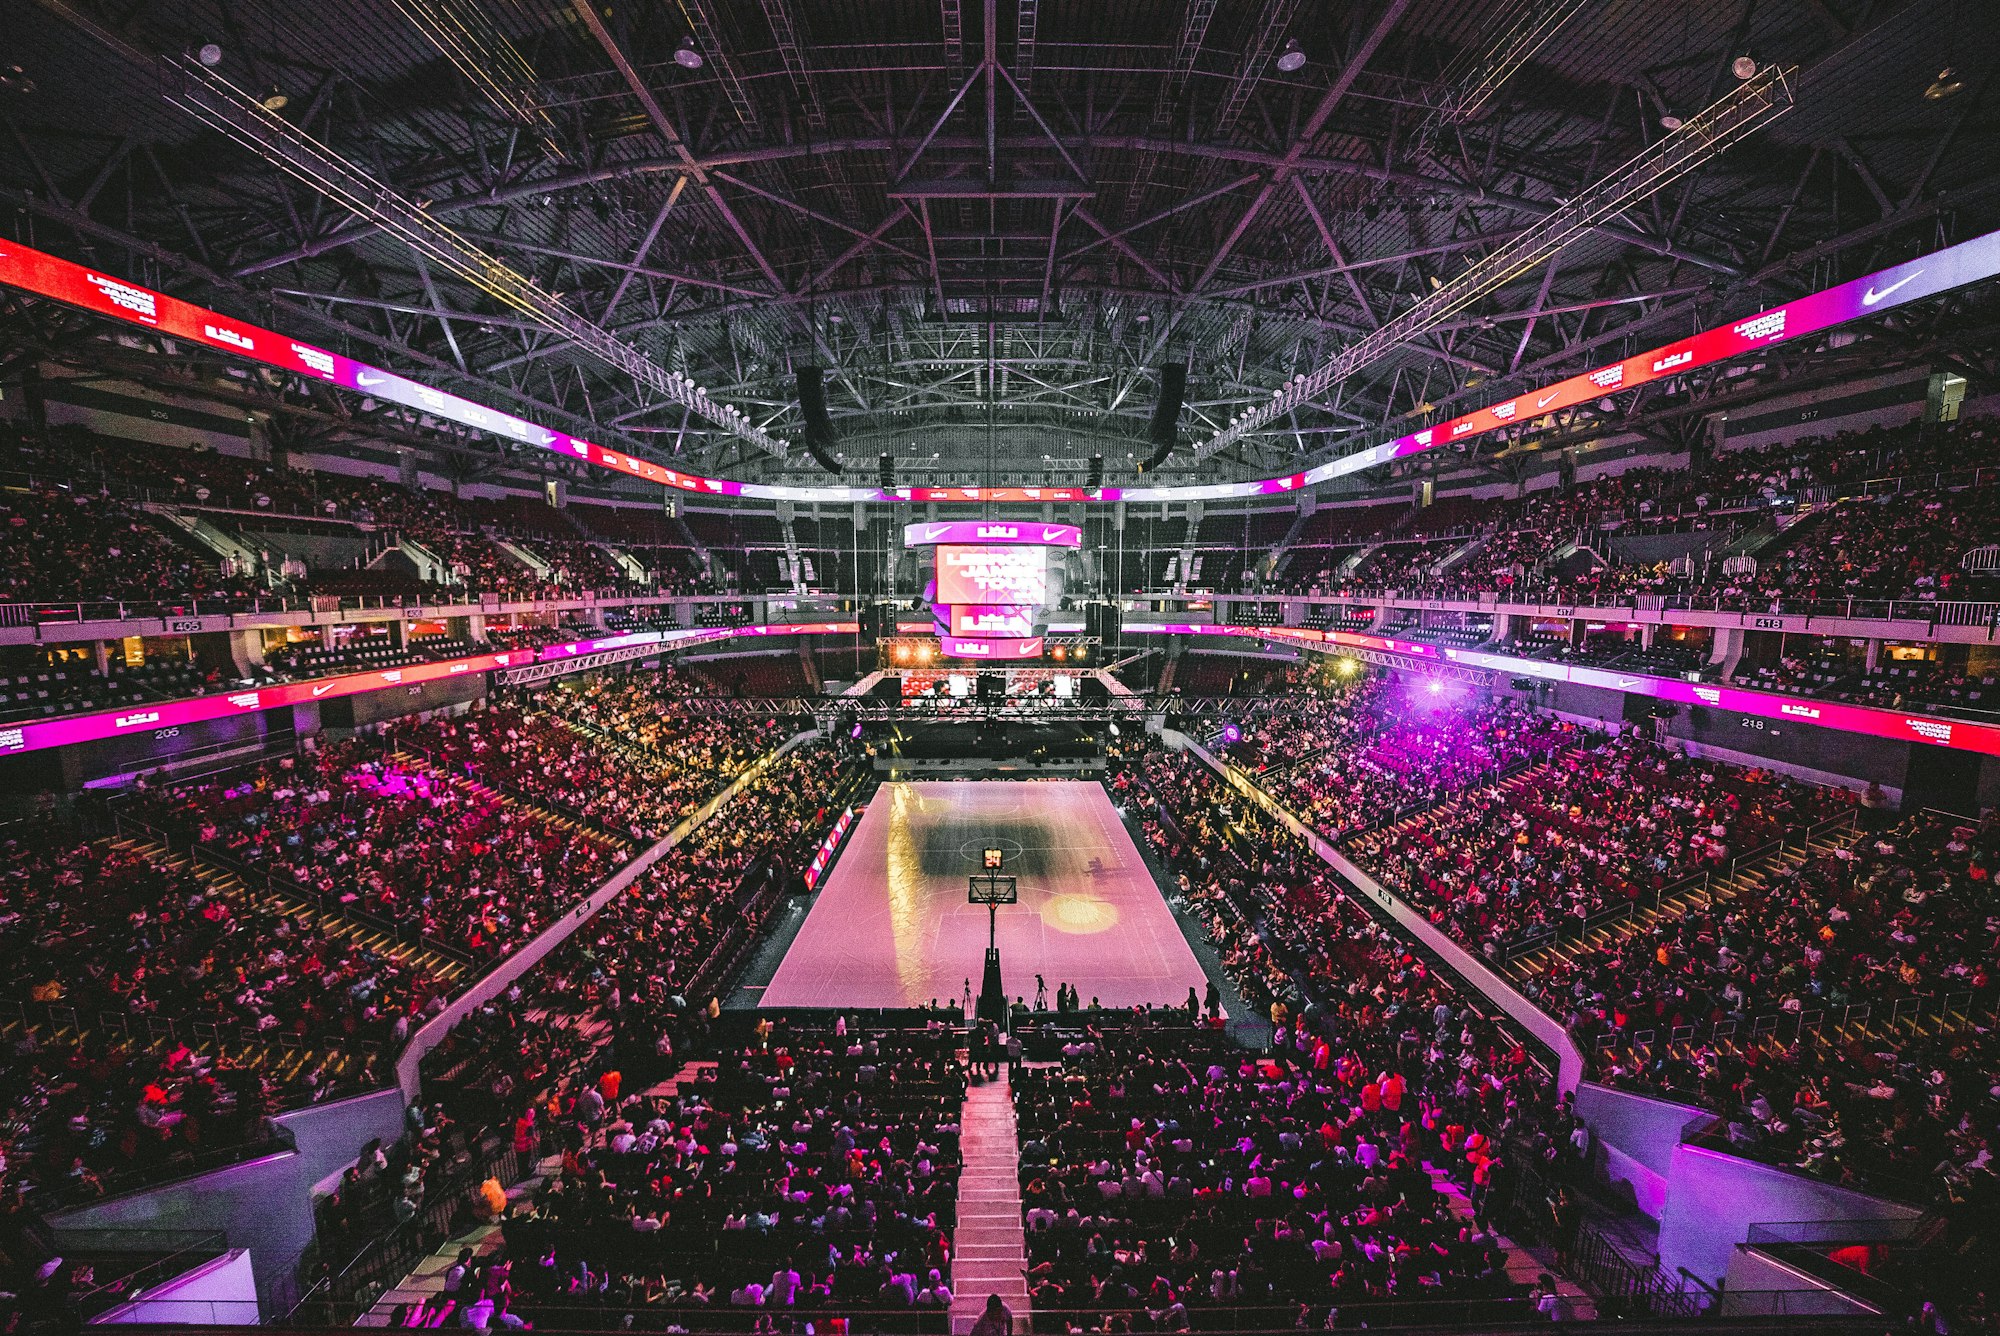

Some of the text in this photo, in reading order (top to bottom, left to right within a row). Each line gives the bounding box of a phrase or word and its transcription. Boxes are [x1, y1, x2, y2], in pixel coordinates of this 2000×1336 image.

[87, 273, 155, 303] LEBRON
[109, 296, 157, 317] TOUR
[1734, 309, 1786, 333] LEBRON
[1747, 323, 1785, 340] TOUR
[1801, 410, 1819, 420] 517
[946, 553, 1038, 566] LEBRON
[974, 577, 1038, 590] TOUR
[176, 621, 200, 631] 405
[1757, 619, 1780, 629] 418
[1741, 718, 1764, 730] 218
[1905, 719, 1953, 731] LEBRON
[154, 727, 180, 739] 205
[1917, 730, 1951, 740] TOUR
